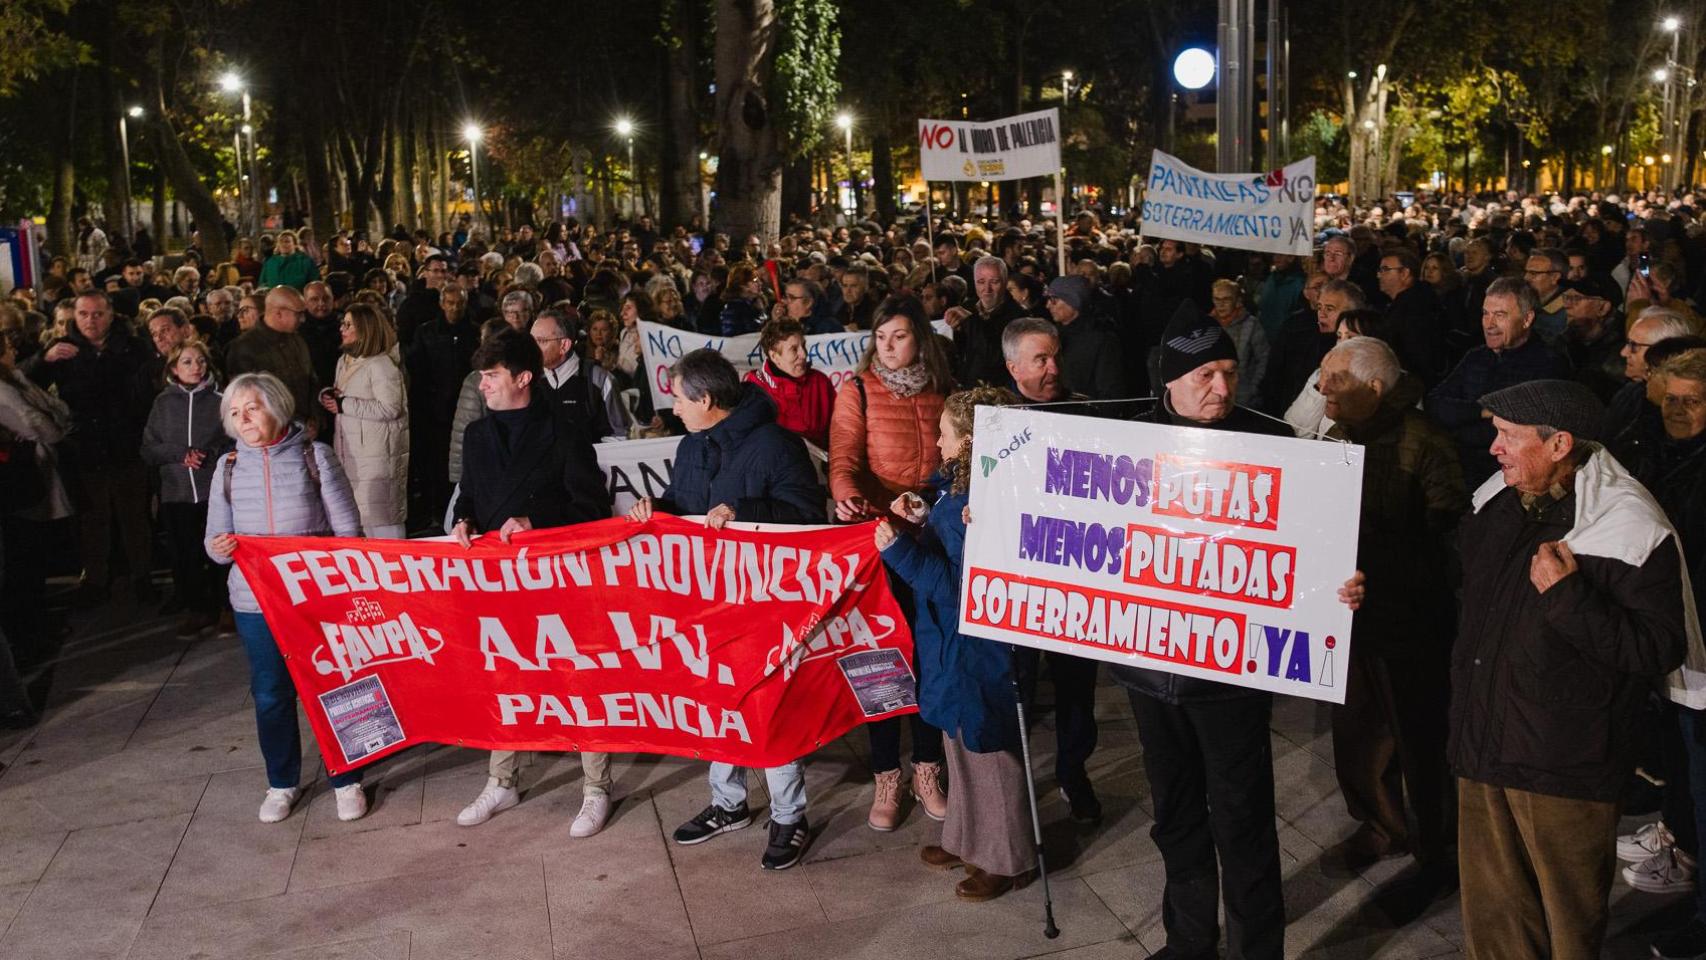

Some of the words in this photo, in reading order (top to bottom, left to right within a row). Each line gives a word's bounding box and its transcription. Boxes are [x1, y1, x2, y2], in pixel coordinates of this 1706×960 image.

[920, 123, 954, 150] NO
[996, 125, 1011, 152] DE
[1009, 116, 1056, 149] PALENCIA
[1151, 164, 1270, 204] PANTALLAS
[1278, 175, 1313, 203] NO
[1142, 200, 1282, 239] SOTERRAMIENTO
[1288, 216, 1309, 245] YA
[647, 330, 684, 359] NO
[998, 426, 1032, 459] adif
[1044, 447, 1155, 508] MENOS
[1157, 457, 1273, 525] PUTAS
[600, 533, 872, 606] PROVINCIAL
[1018, 513, 1125, 576] MENOS
[1129, 529, 1291, 602] PUTADAS
[320, 611, 435, 683] FAVPA
[970, 575, 1240, 674] SOTERRAMIENTO
[495, 692, 753, 744] PALENCIA
